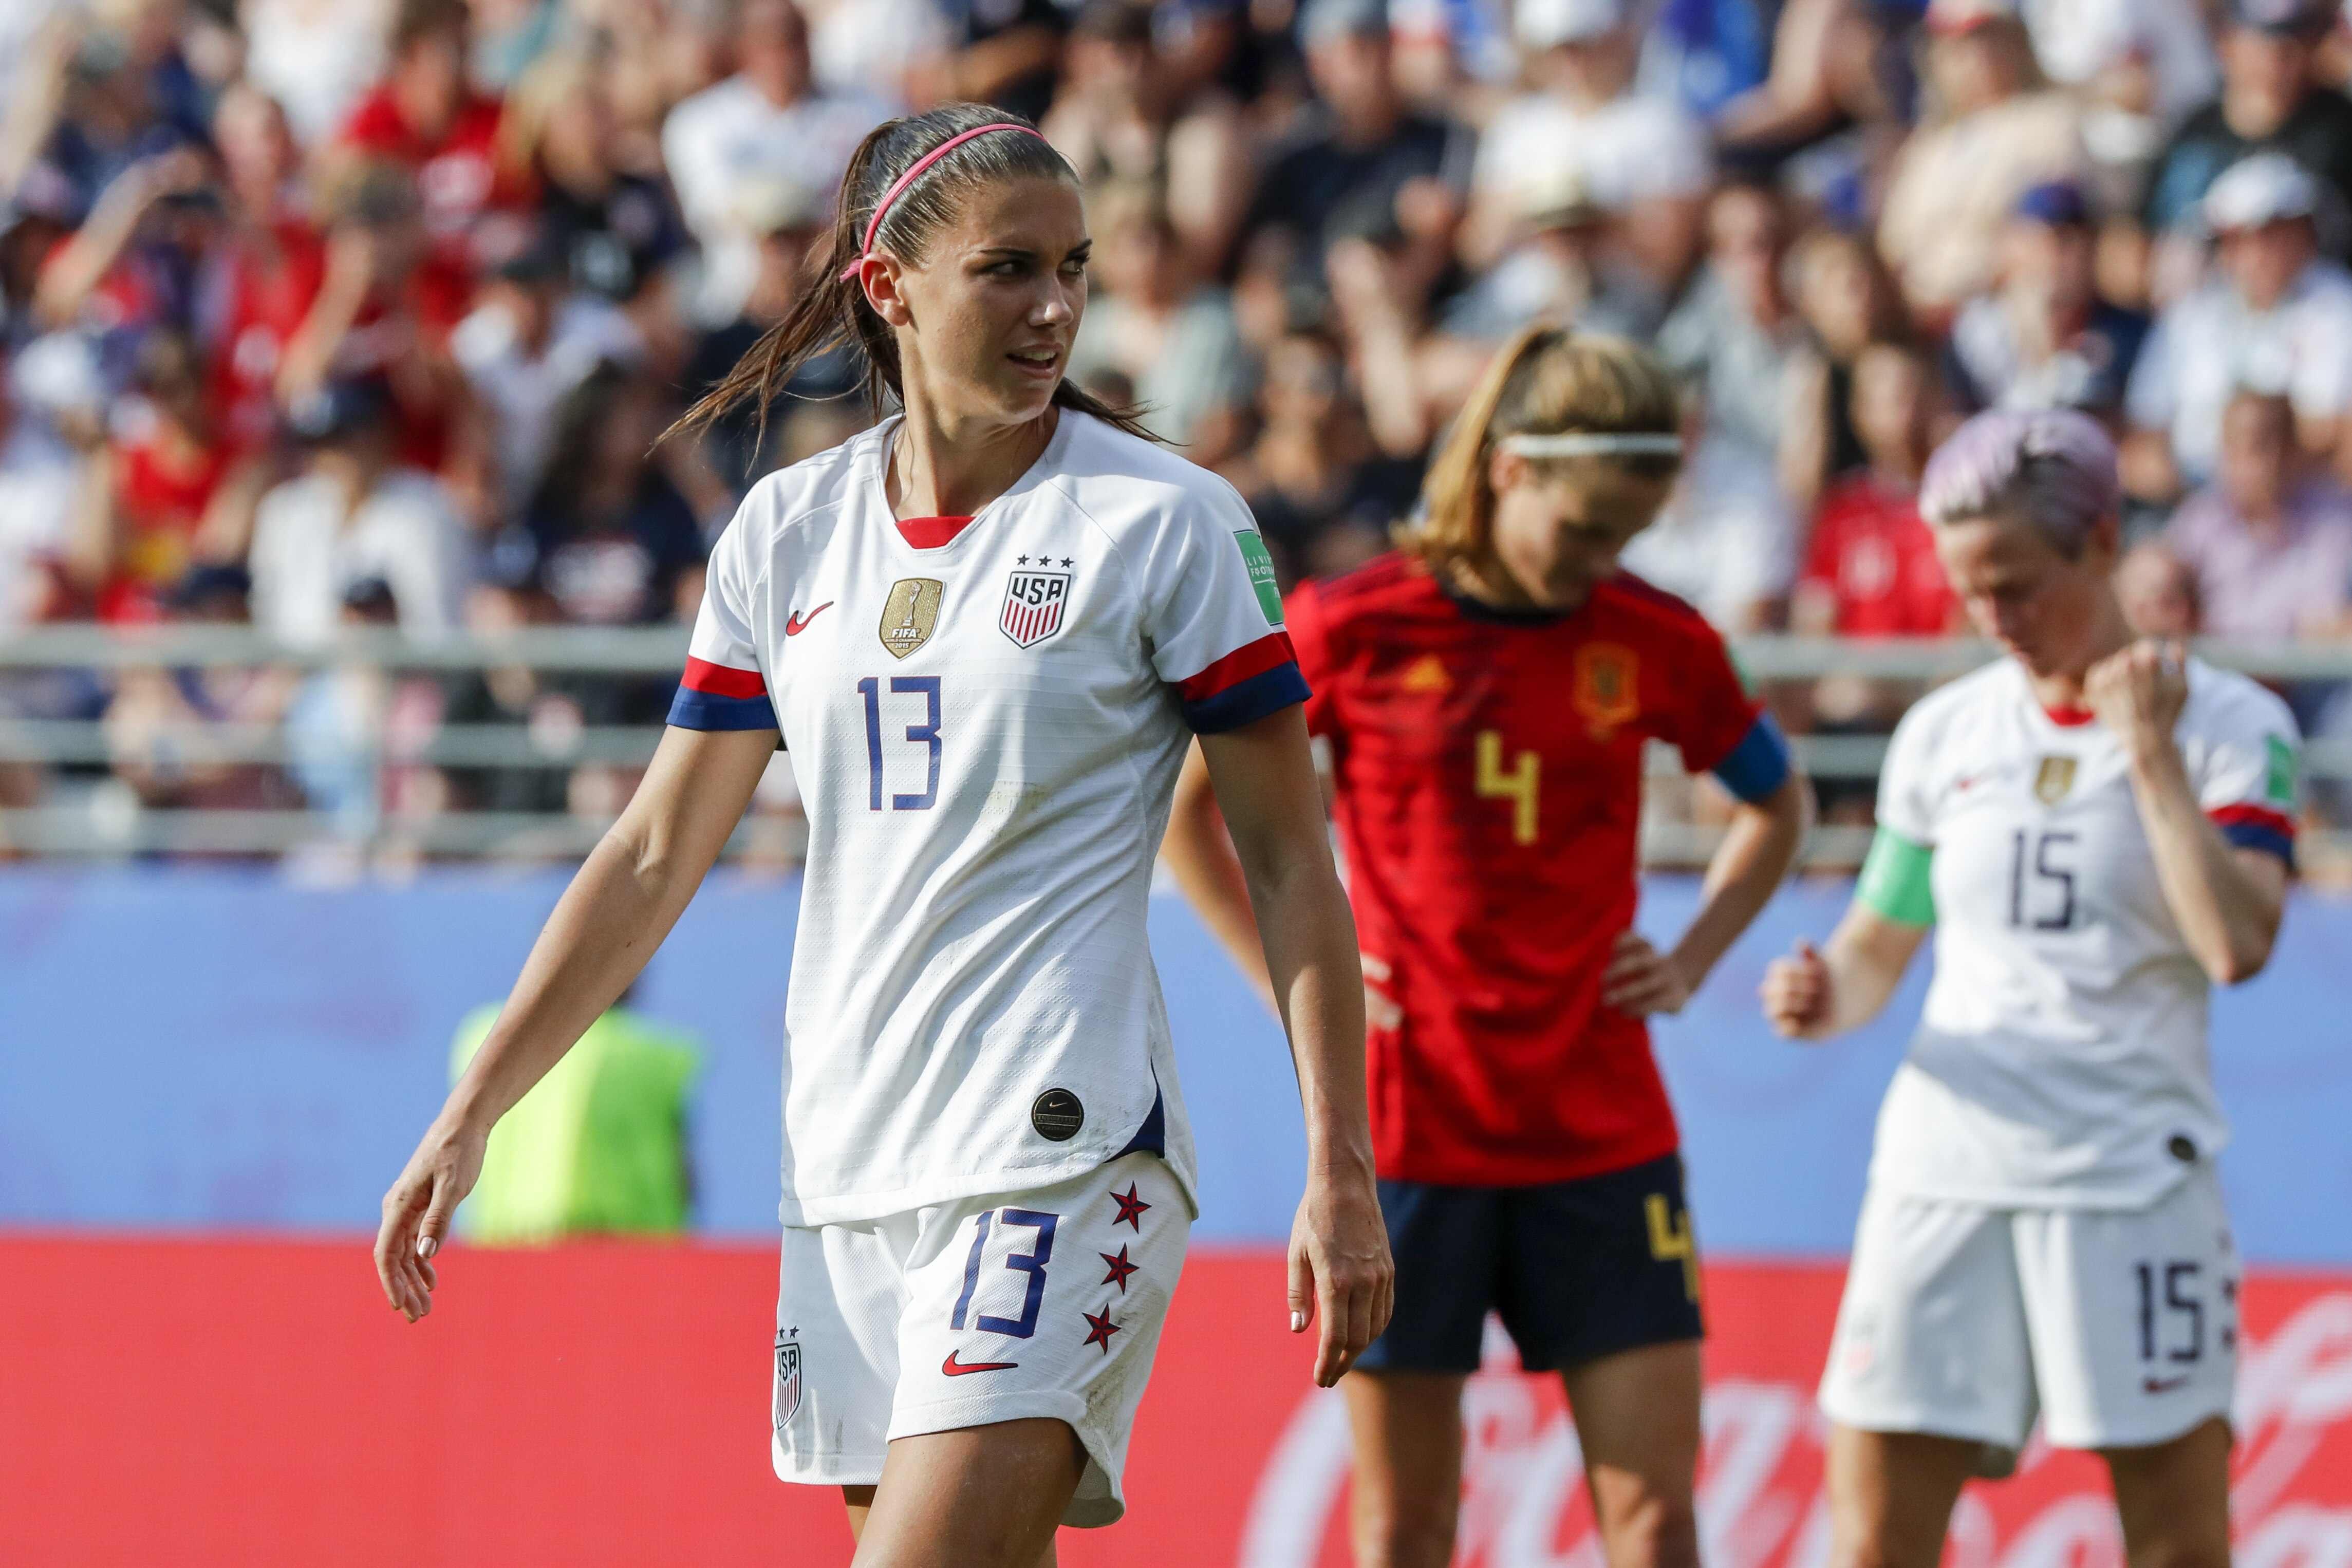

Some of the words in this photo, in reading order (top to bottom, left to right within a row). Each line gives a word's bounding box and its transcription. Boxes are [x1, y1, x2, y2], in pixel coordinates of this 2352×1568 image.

[891, 628, 917, 638] FIFA
[1012, 577, 1063, 605] USA
[857, 676, 942, 811] 13
[1474, 729, 1541, 846] 4
[2010, 828, 2076, 930] 15
[950, 1208, 1059, 1339] 13
[1643, 1192, 1700, 1304] 4
[2135, 1259, 2204, 1365] 15
